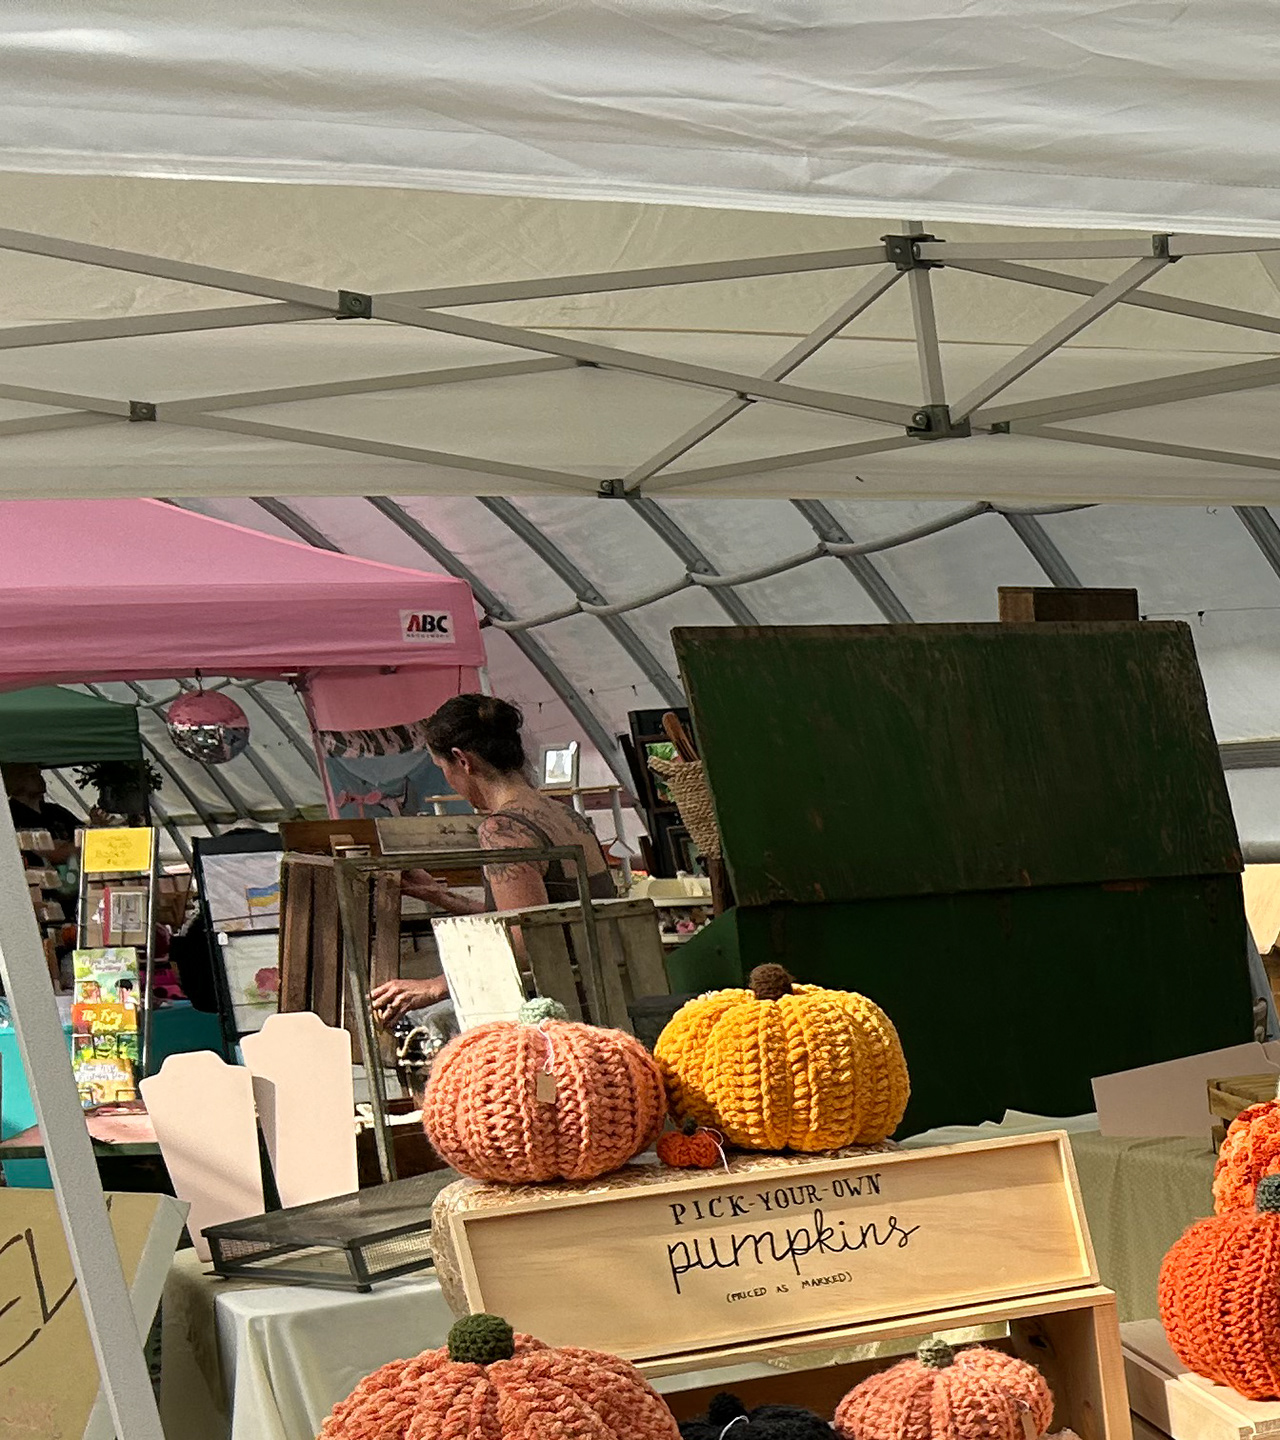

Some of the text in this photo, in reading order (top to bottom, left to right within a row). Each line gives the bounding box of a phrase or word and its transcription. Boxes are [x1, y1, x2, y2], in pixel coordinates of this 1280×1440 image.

[406, 614, 449, 633] ABC
[666, 1208, 921, 1295] pumpkins
[725, 1270, 854, 1303] (PRICED AS MARKED)
